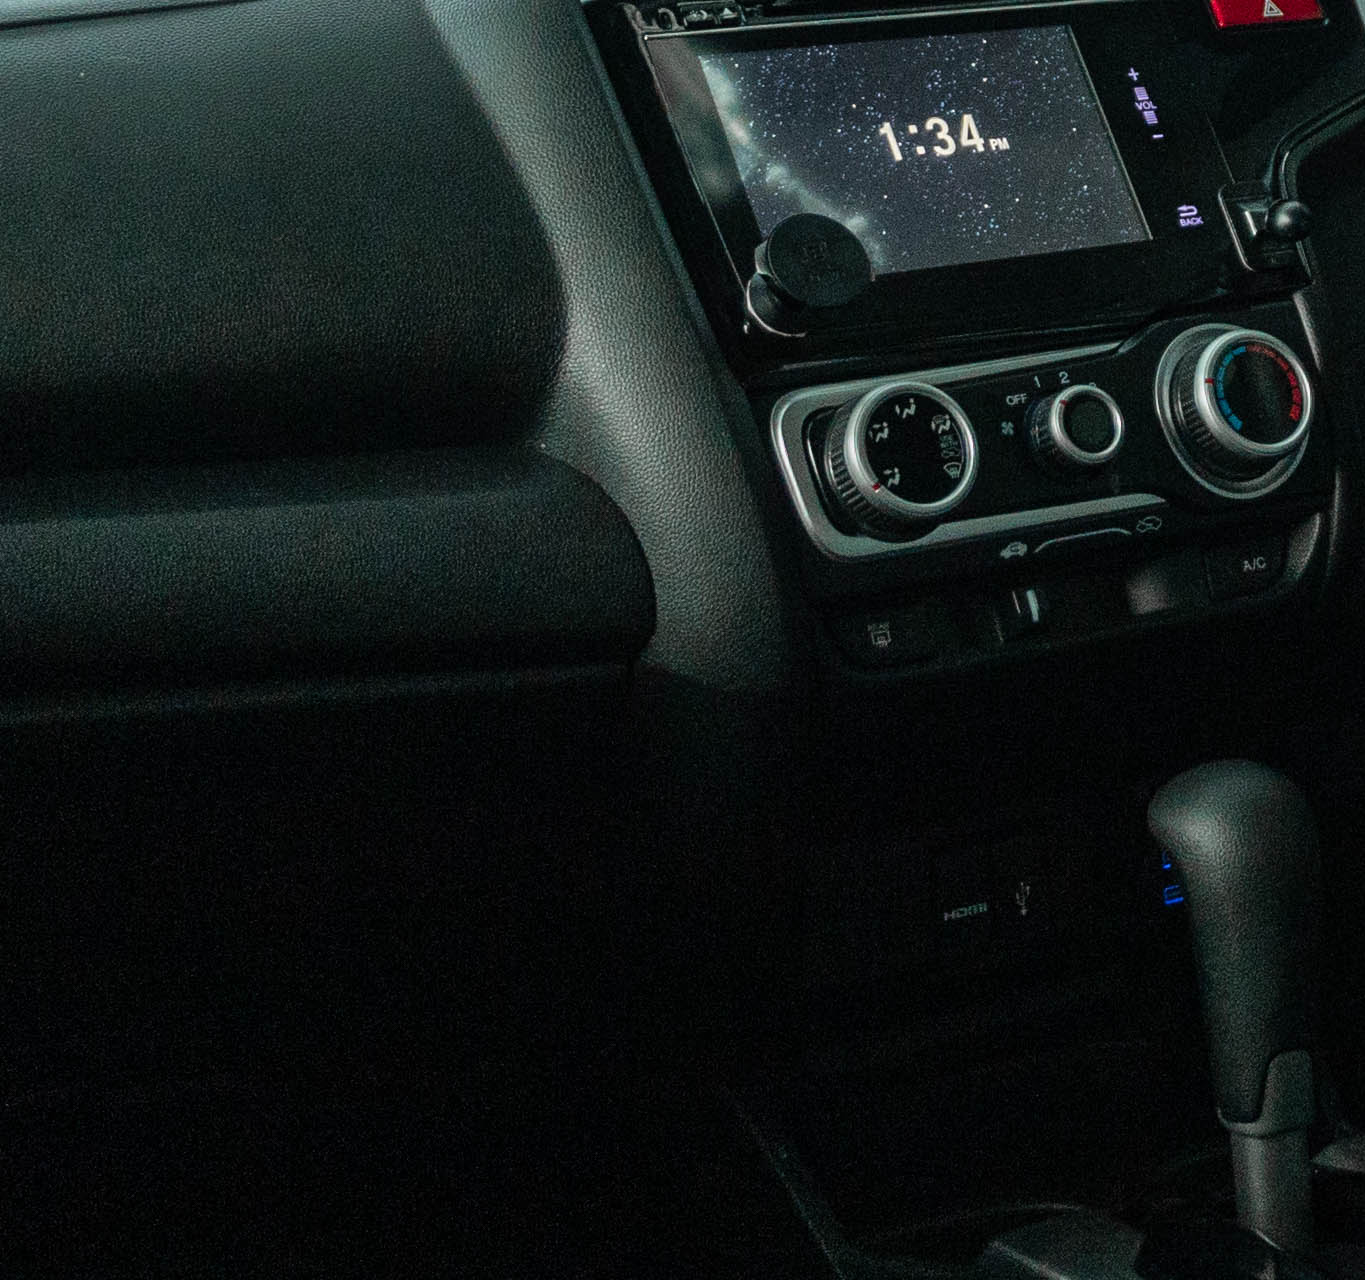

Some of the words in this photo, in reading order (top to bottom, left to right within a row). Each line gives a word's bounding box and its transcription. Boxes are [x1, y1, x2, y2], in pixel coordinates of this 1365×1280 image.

[1134, 100, 1158, 111] VOL
[879, 114, 985, 162] 1:34
[989, 137, 1010, 151] PM
[1178, 216, 1204, 228] BACK
[1033, 375, 1042, 389] 1
[1058, 371, 1071, 385] 2
[1005, 392, 1028, 406] OFF
[1242, 556, 1268, 573] A/C
